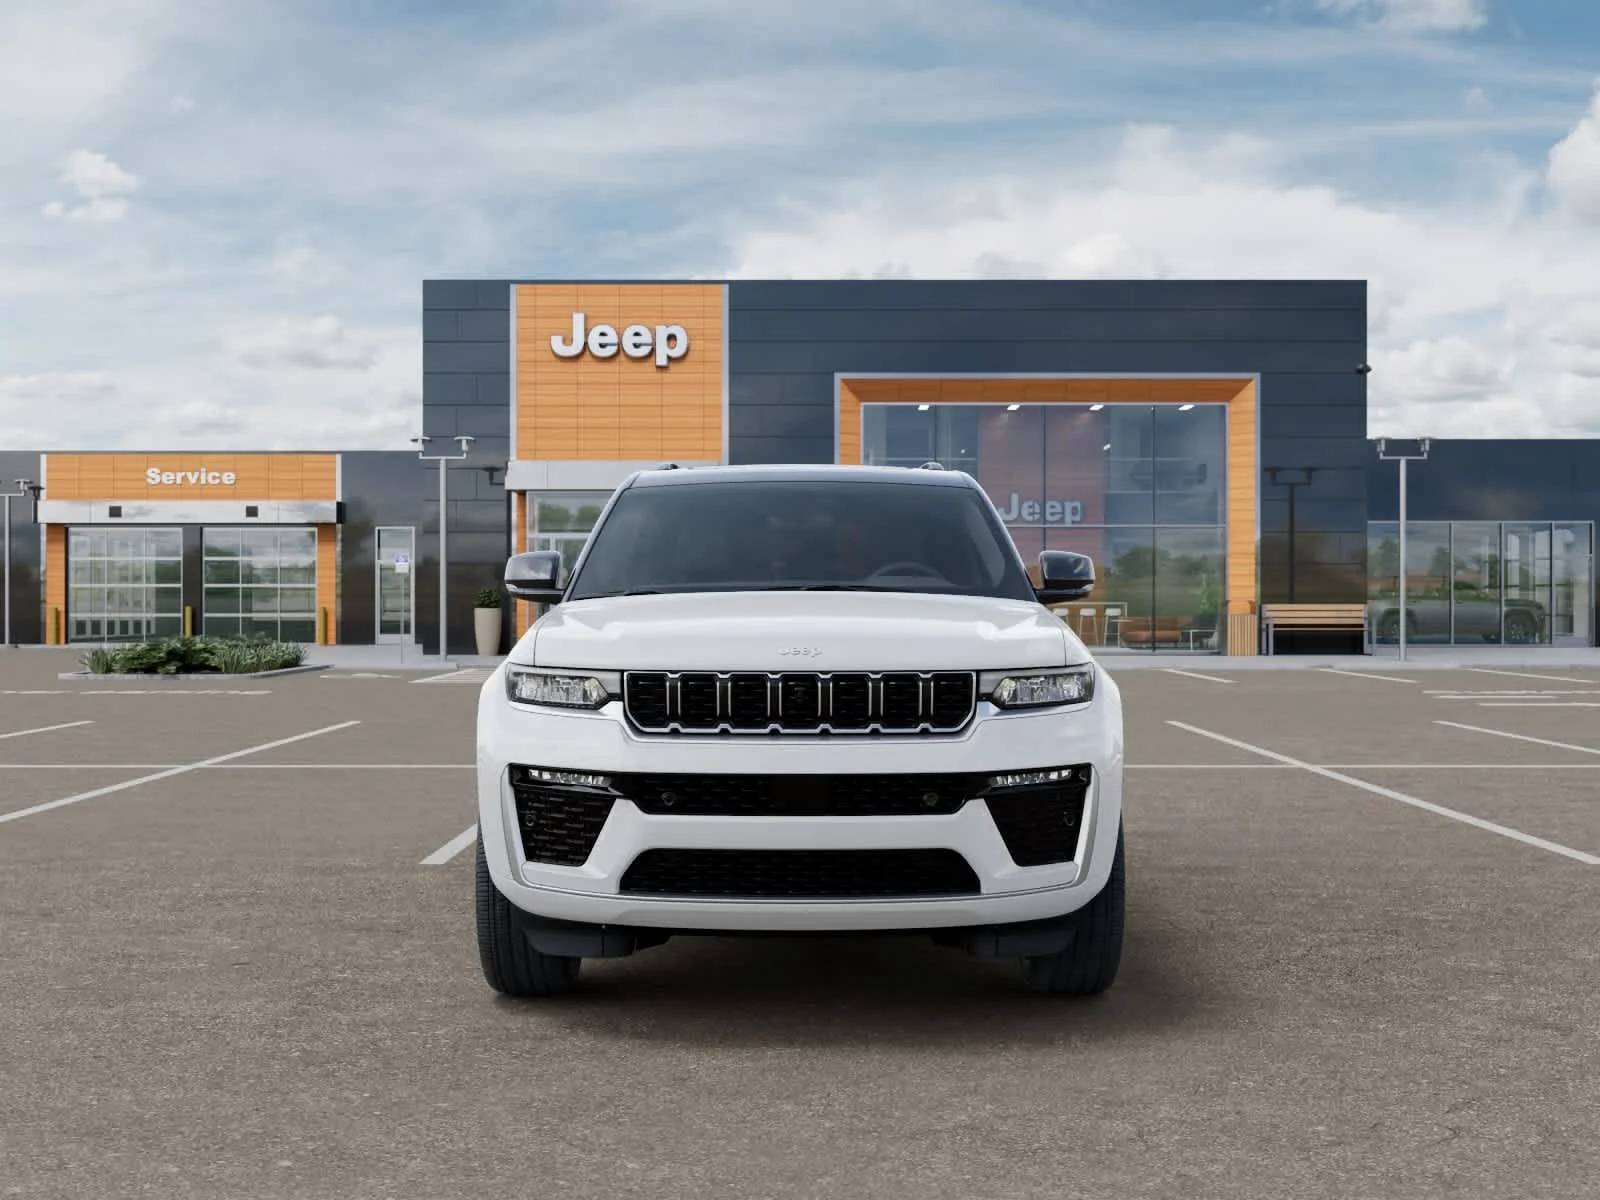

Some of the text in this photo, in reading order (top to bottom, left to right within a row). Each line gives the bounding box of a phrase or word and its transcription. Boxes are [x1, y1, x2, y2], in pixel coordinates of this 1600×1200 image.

[550, 311, 689, 367] Jeep
[145, 467, 236, 485] Service
[999, 492, 1083, 525] Jeep
[777, 646, 822, 660] Jeep
